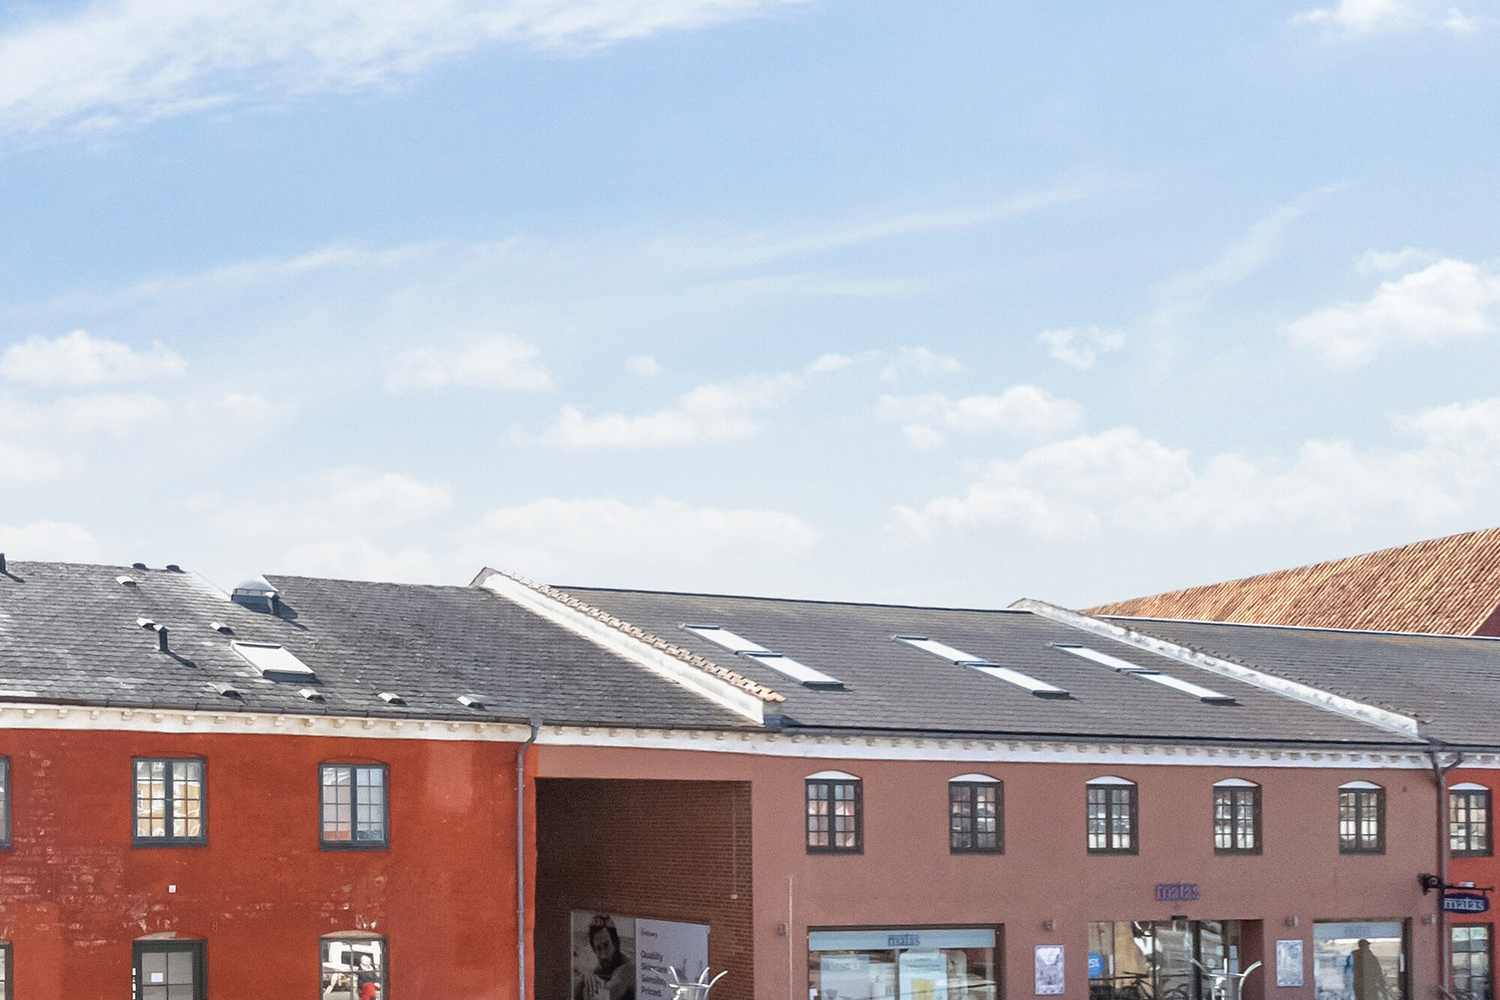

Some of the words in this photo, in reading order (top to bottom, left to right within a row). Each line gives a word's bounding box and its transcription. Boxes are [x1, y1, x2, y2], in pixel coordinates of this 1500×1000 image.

[1155, 882, 1199, 901] matas
[1443, 897, 1485, 911] matas
[887, 933, 920, 947] matas
